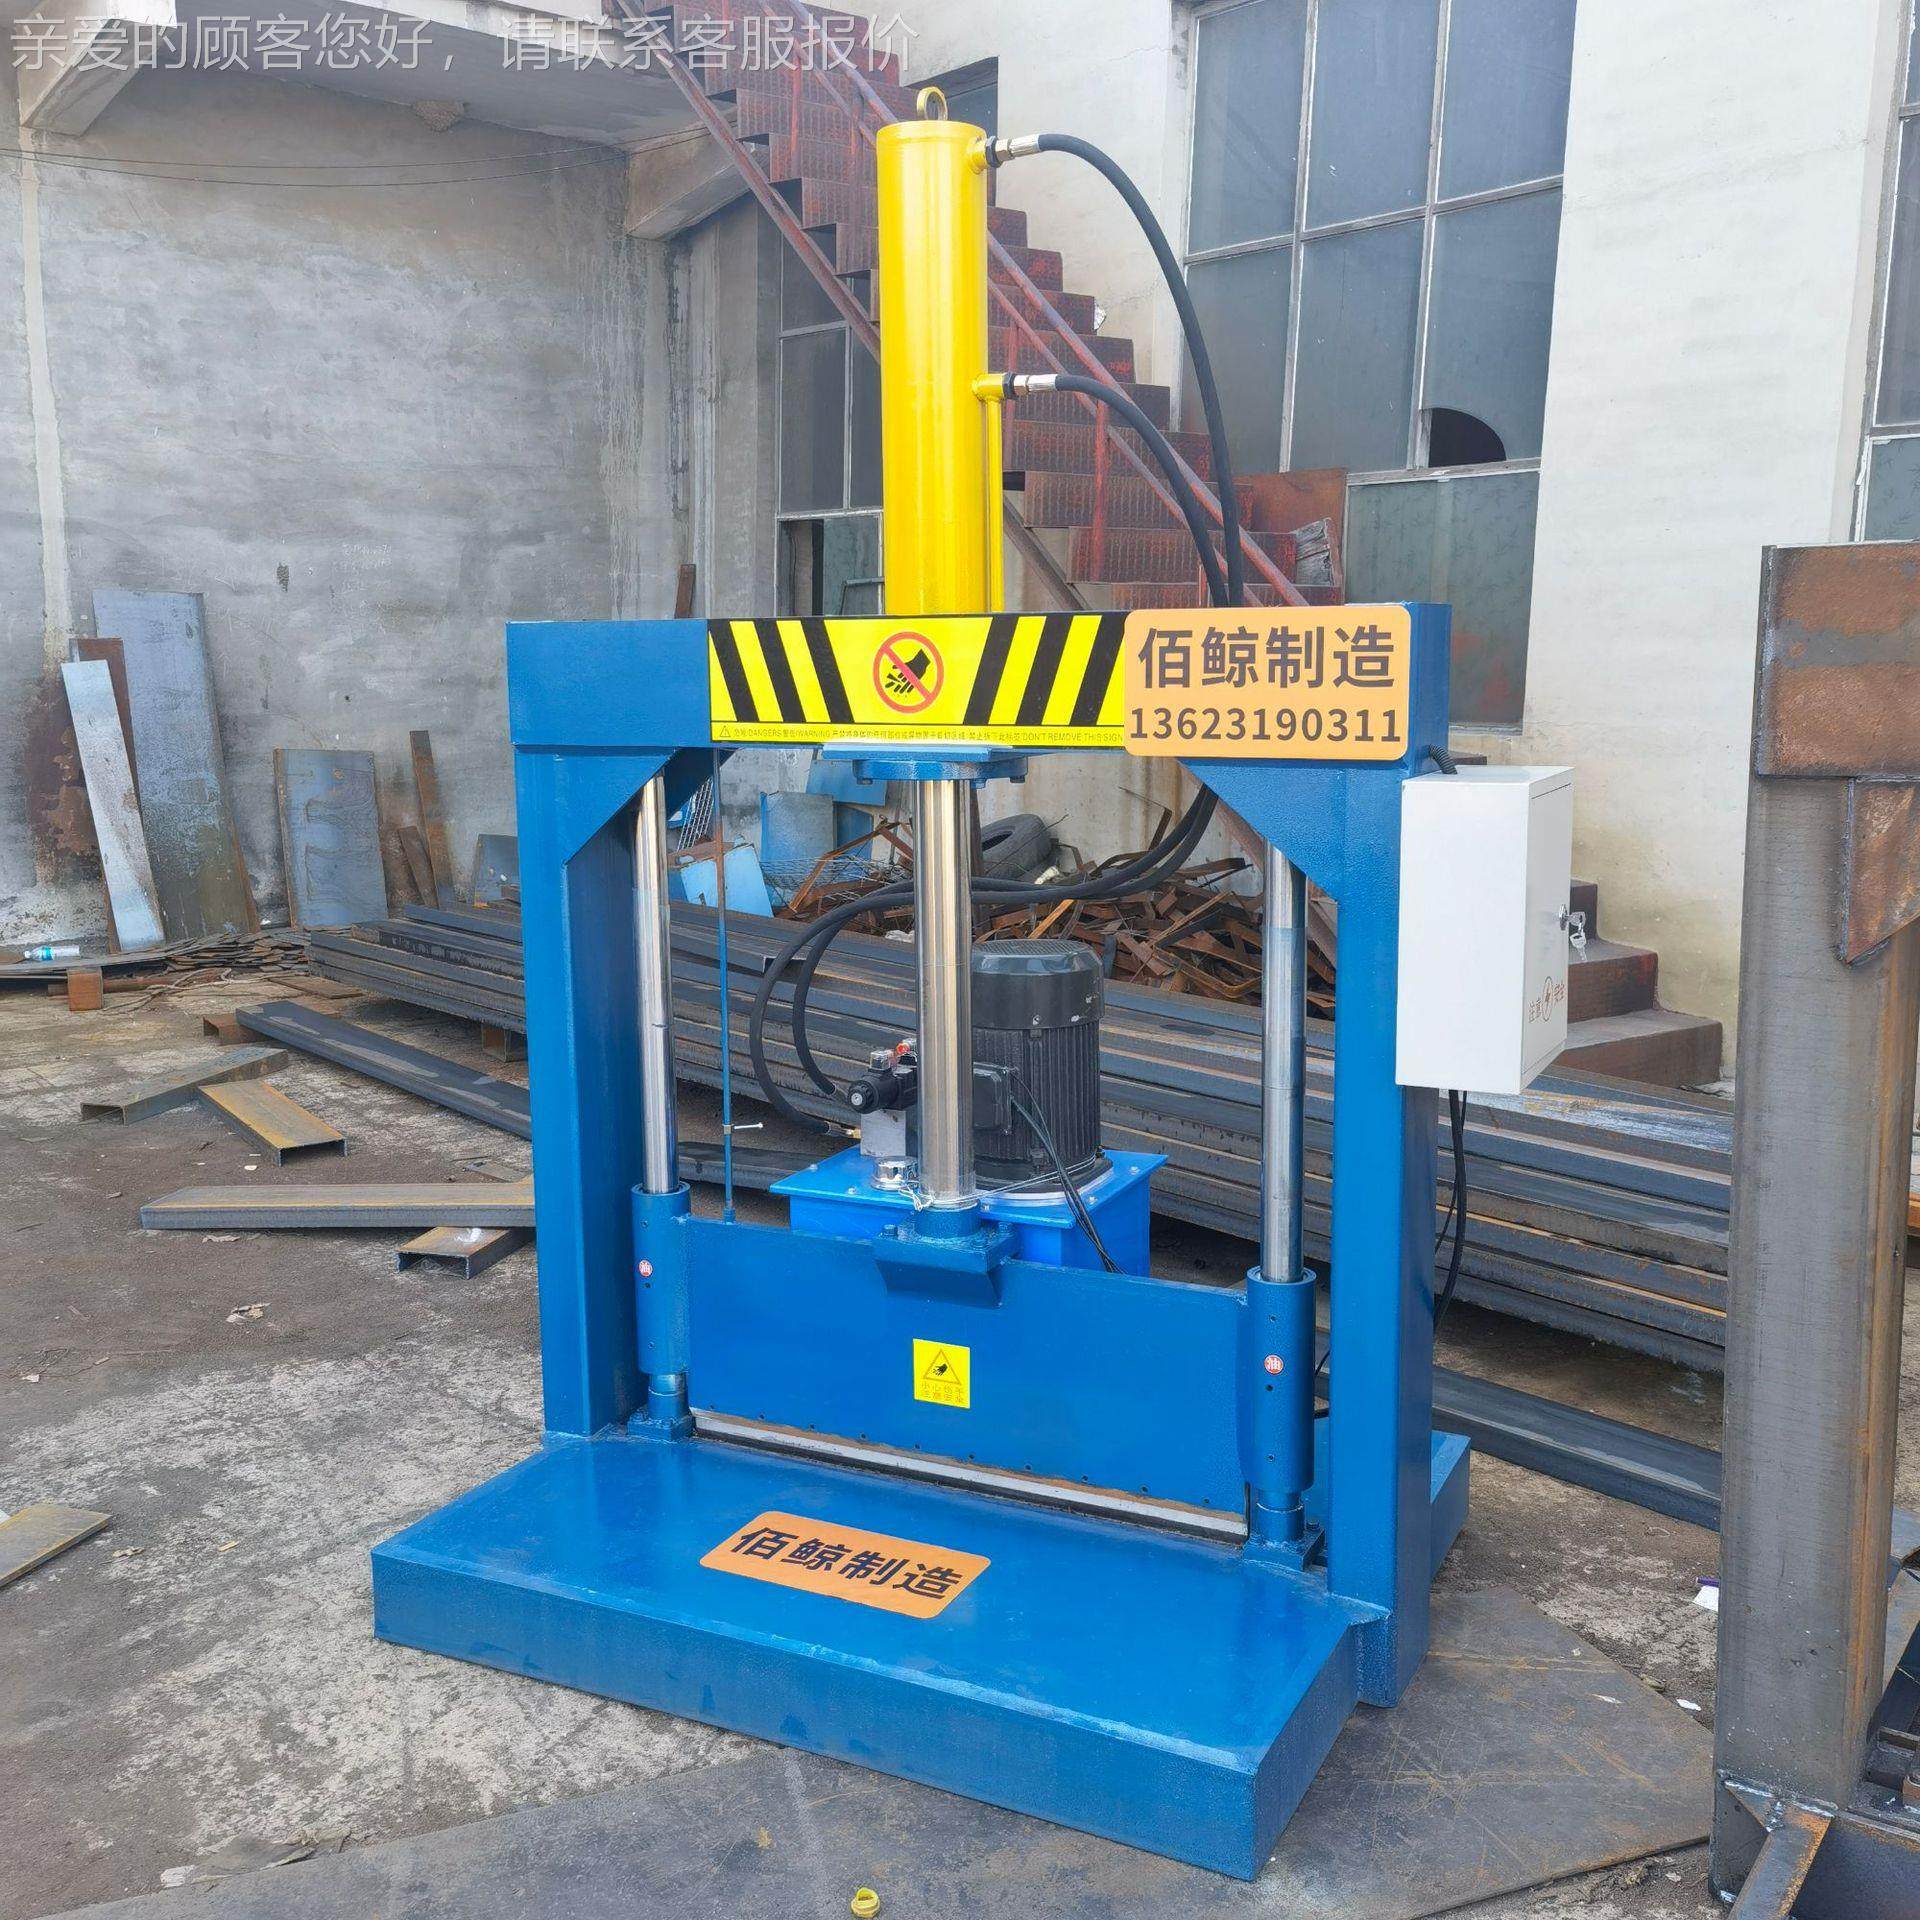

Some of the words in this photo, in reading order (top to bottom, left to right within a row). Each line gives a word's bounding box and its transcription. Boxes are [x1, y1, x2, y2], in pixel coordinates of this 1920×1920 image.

[1138, 624, 1395, 689] 佰鲸制造
[1130, 707, 1401, 742] 13623190311
[730, 1527, 965, 1600] 佰鲸制造
